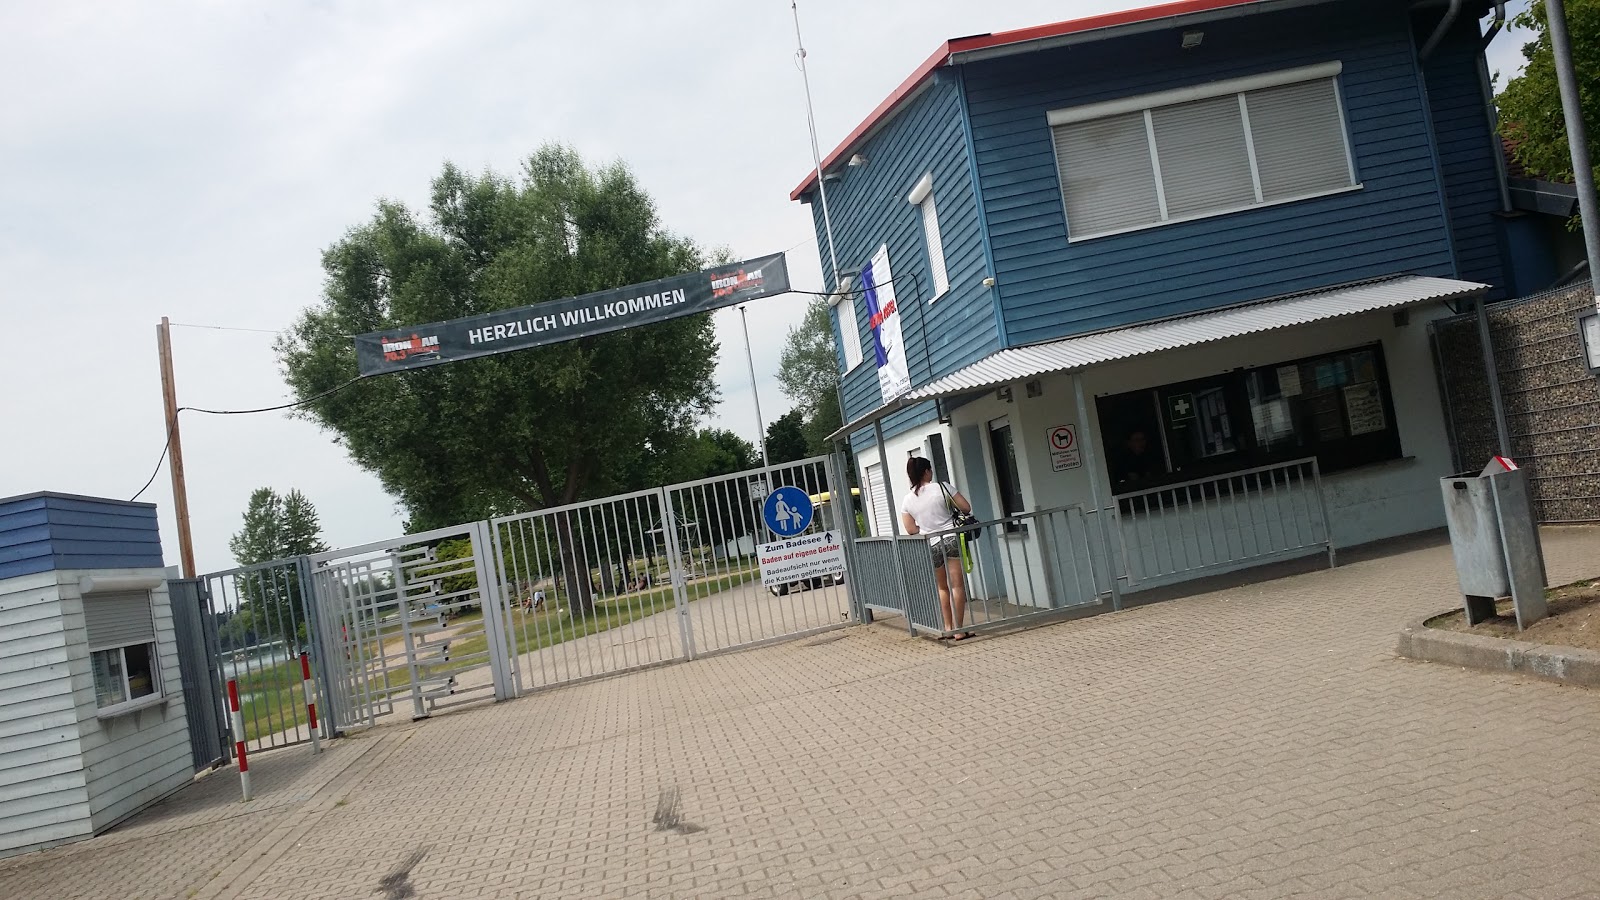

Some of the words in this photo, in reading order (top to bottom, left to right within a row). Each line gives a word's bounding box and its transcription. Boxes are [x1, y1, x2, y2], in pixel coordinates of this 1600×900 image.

[711, 269, 763, 290] IRONMAN
[468, 315, 557, 344] HERZLICH
[560, 288, 686, 327] WILLKOMMEN
[382, 334, 440, 353] IRONMAN
[384, 350, 407, 362] 70.3
[1055, 461, 1080, 469] verboten
[765, 544, 784, 553] Zum
[785, 536, 822, 549] Badesee
[761, 555, 783, 565] Baden
[783, 553, 794, 561] auf
[795, 549, 818, 558] eigene
[818, 544, 840, 554] Gefahr
[766, 562, 809, 576] Badeaufsicht
[821, 556, 840, 564] wenn
[776, 573, 800, 582] Kassen
[800, 568, 828, 579] geöffnet
